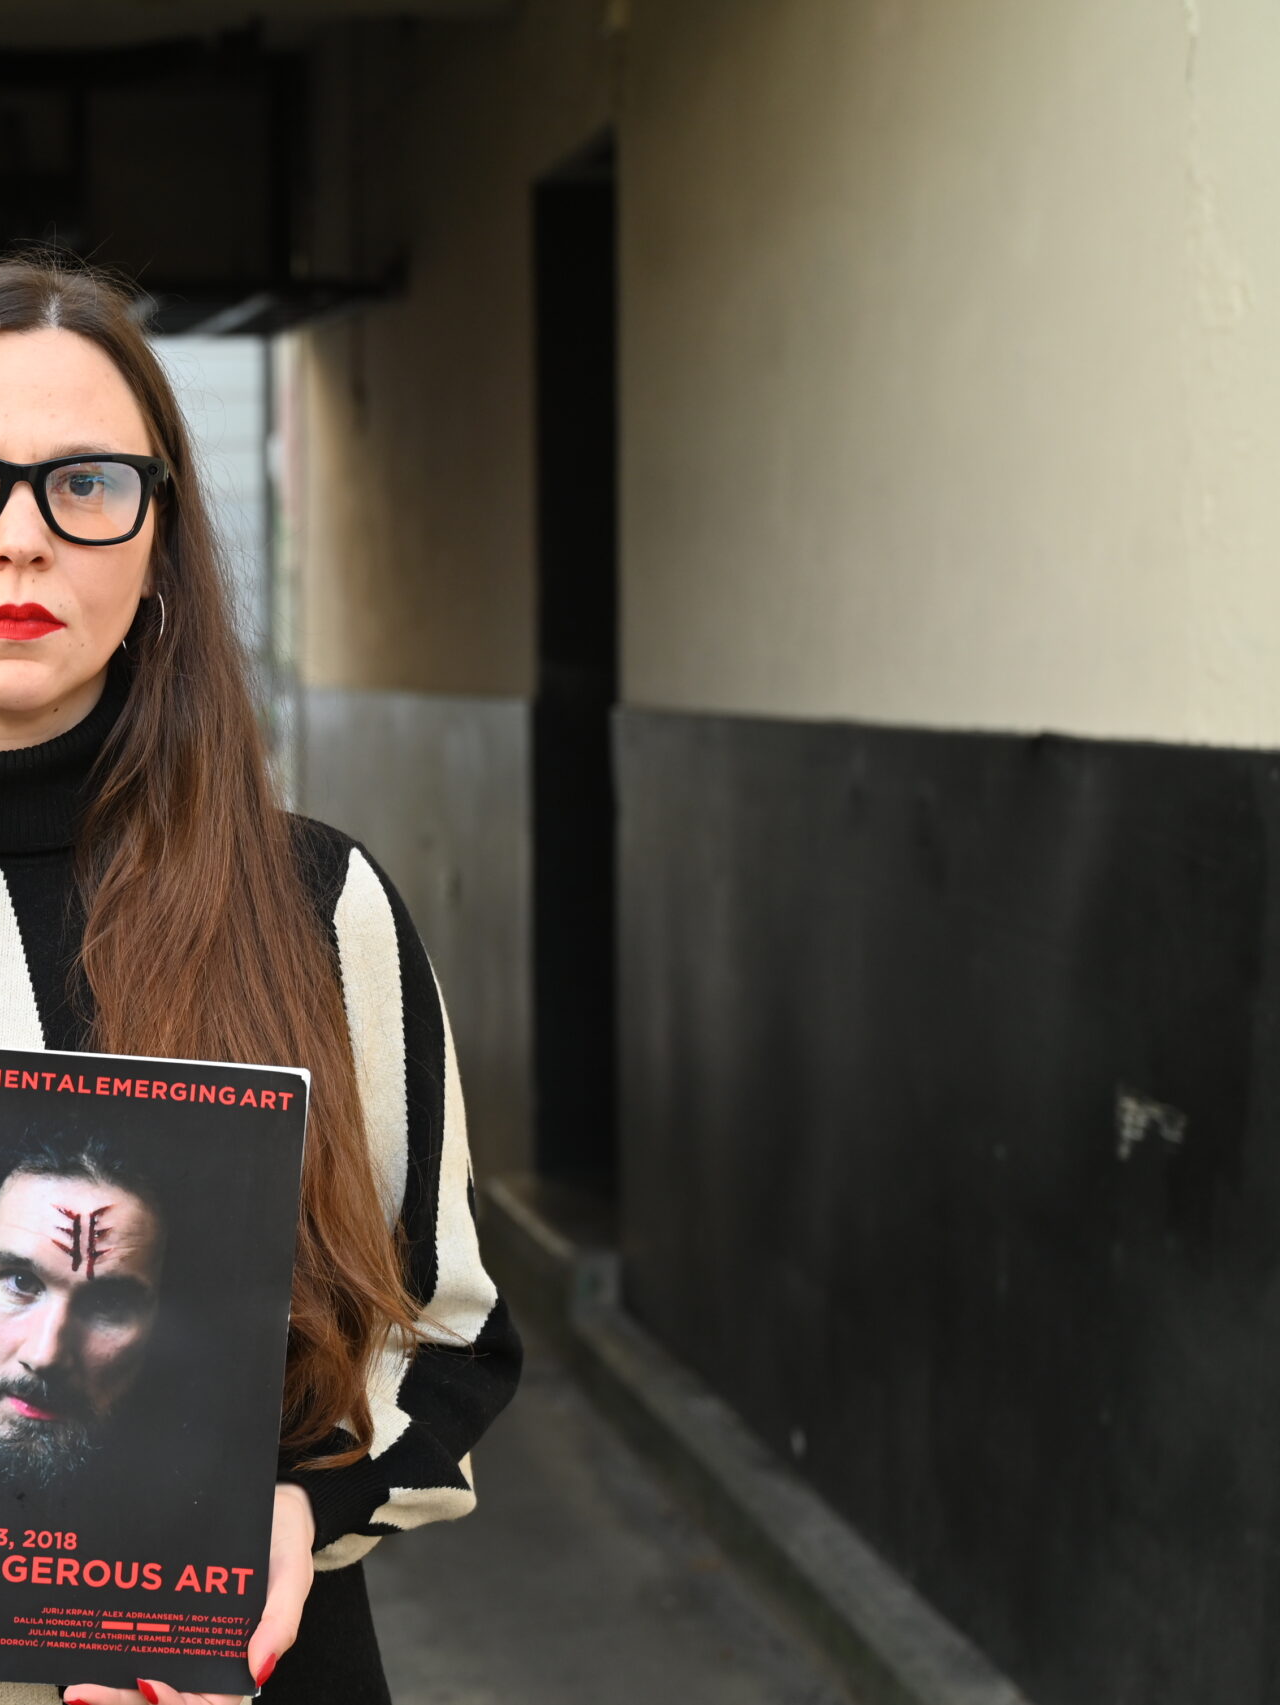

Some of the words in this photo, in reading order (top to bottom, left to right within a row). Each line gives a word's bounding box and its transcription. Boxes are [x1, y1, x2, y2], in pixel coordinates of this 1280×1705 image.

[22, 1529, 78, 1550] 2018
[174, 1564, 254, 1596] ART
[13, 1616, 44, 1625] DALILA
[45, 1618, 94, 1627] HONORATO
[178, 1625, 210, 1634] MARNIX
[41, 1607, 64, 1615] JURIJ
[66, 1608, 94, 1616] KRPAN
[125, 1612, 184, 1621] ADRIAANSENS
[211, 1617, 244, 1625] ASCOTT
[28, 1629, 58, 1637] JULIAN
[59, 1631, 87, 1639] BLAUE
[95, 1632, 136, 1641] CATHRINE
[138, 1635, 172, 1643] KRAMER
[180, 1637, 202, 1645] ZACK
[204, 1638, 242, 1647] DENFELD
[47, 1641, 77, 1649] MARKO
[78, 1642, 123, 1651] MARKOVIĆ
[131, 1645, 181, 1654] ALEXANDRA
